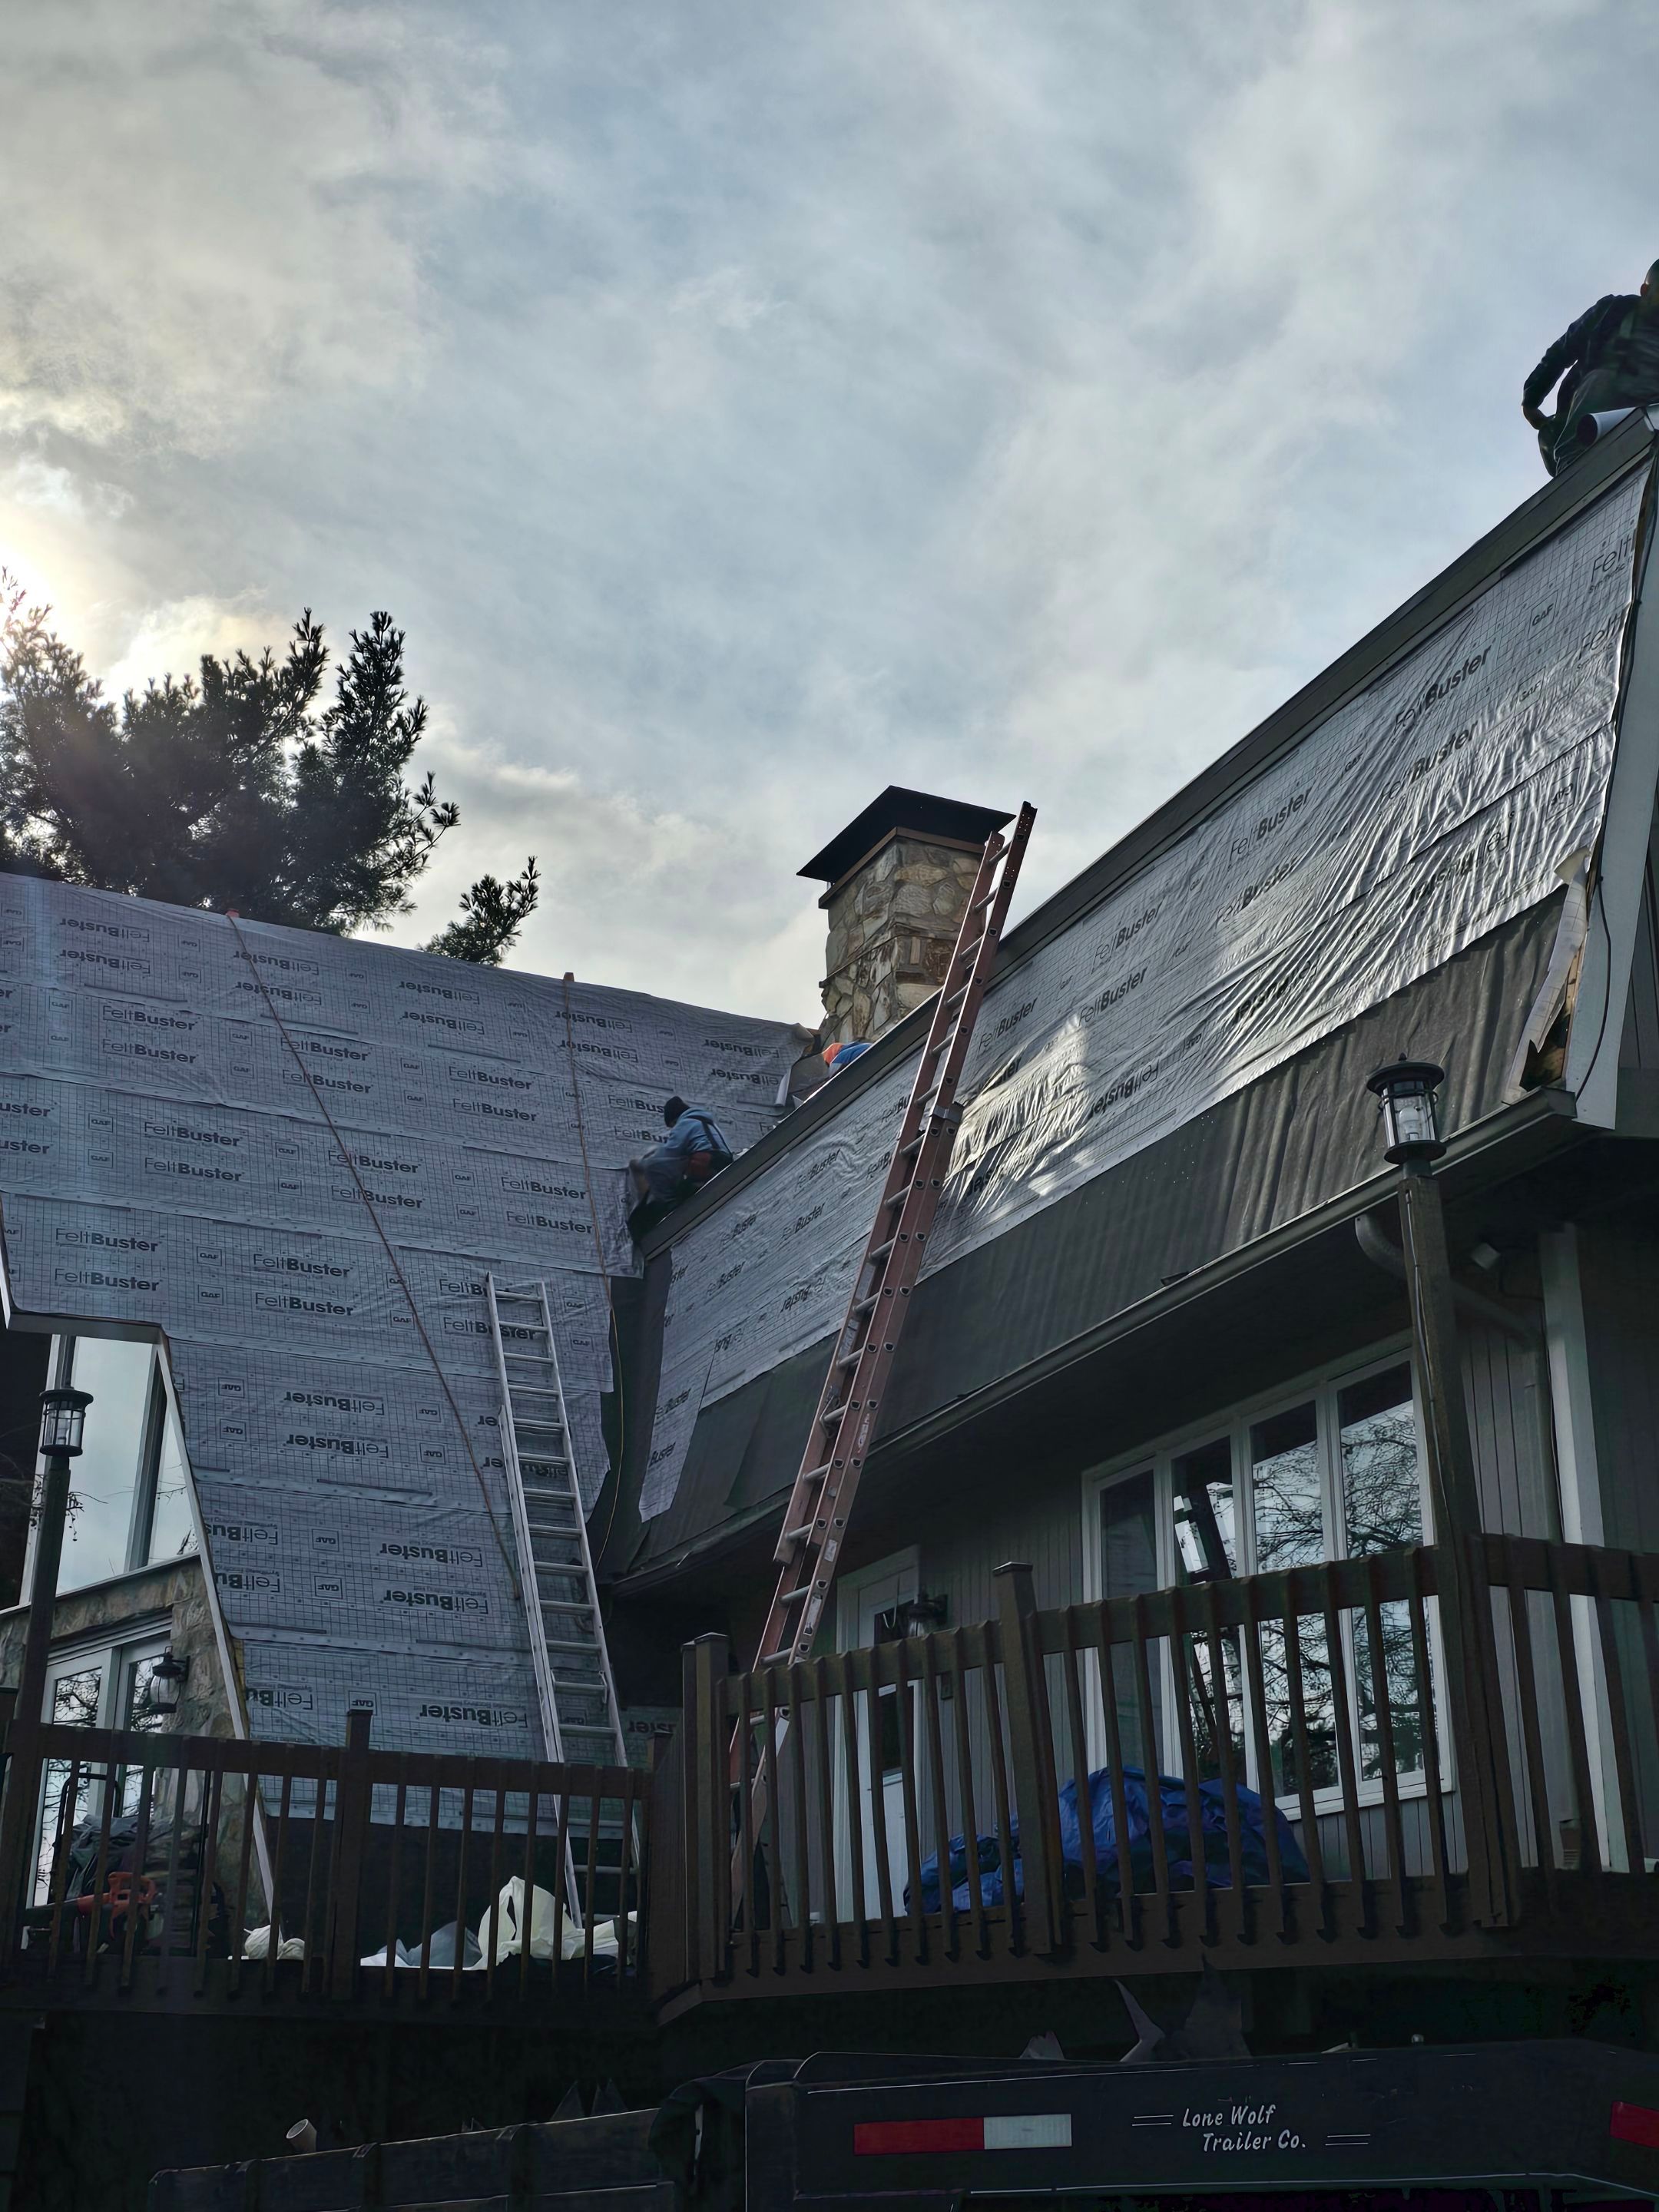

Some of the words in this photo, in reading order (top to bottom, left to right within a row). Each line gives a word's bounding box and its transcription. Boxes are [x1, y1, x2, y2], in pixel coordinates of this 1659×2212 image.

[1532, 604, 1555, 627] GAF
[1229, 788, 1312, 861] FeltBuster
[60, 918, 149, 942] FeltBuster
[1094, 906, 1161, 965] FeltBuster
[60, 949, 150, 974] FeltBuster
[233, 951, 318, 975] FeltBuster
[235, 981, 321, 1005] FeltBuster
[399, 981, 479, 1005] FeltBuster
[1080, 966, 1147, 1026] FeltBuster
[103, 1005, 195, 1031] FeltBuster
[403, 1011, 485, 1035] FeltBuster
[555, 1011, 632, 1032] FeltBuster
[103, 1038, 195, 1063] FeltBuster
[281, 1038, 368, 1061] FeltBuster
[560, 1040, 638, 1063] FeltBuster
[704, 1039, 780, 1058] FeltBuster
[283, 1070, 371, 1093] FeltBuster
[449, 1067, 531, 1090] FeltBuster
[711, 1068, 779, 1086] eltBuster
[453, 1098, 537, 1121] FeltBuster
[609, 1095, 664, 1113] FeltBus
[144, 1122, 240, 1147] FeltBuster
[145, 1157, 242, 1181] FeltBuster
[329, 1150, 419, 1174] FeltBuster
[332, 1185, 422, 1209] FeltBuster
[502, 1177, 586, 1200] FeltBuster
[507, 1211, 592, 1234] FeltBuster
[56, 1228, 157, 1252] FeltBuster
[253, 1253, 349, 1277] FeltBuster
[55, 1268, 159, 1291] FeltBuster
[255, 1292, 353, 1316] FeltBuster
[443, 1317, 535, 1340] FeltBster
[221, 1383, 242, 1392] GAF
[284, 1391, 384, 1416] FeltBuster
[223, 1426, 243, 1435] GAF
[286, 1434, 388, 1459] FeltBuster
[379, 1542, 482, 1568] FeltBuster
[215, 1573, 280, 1593] FeltBu
[384, 1589, 488, 1614] FeltBuster
[247, 1690, 313, 1710] FeltBu
[420, 1704, 528, 1728] FeltBuster
[1182, 2108, 1223, 2127] Lone
[1231, 2104, 1276, 2125] Wolf
[1204, 2131, 1271, 2151] Trailer
[1278, 2129, 1306, 2149] Co.
